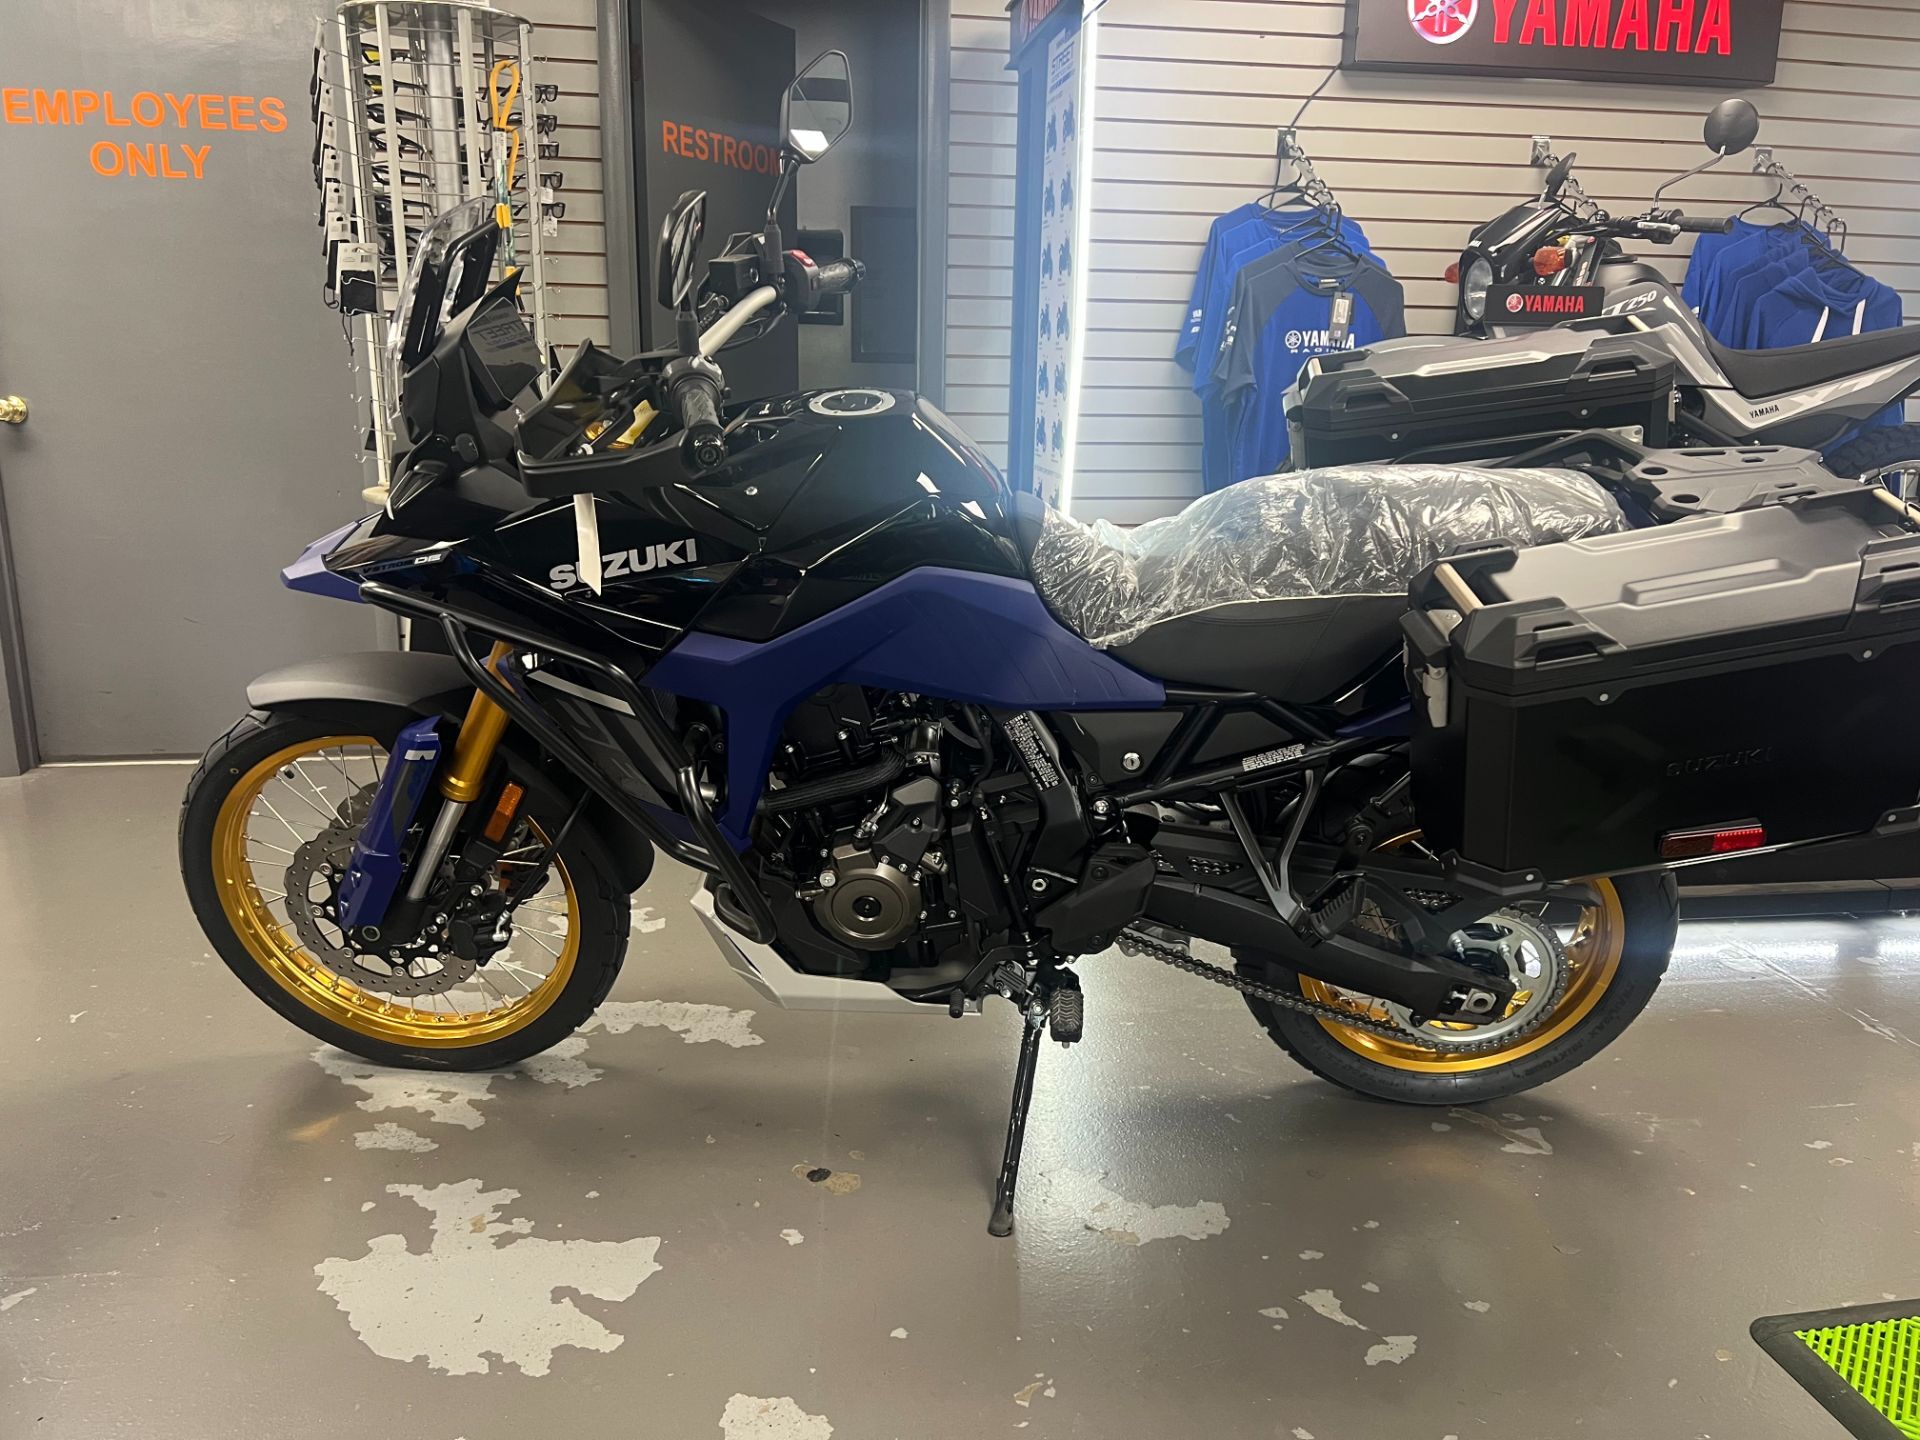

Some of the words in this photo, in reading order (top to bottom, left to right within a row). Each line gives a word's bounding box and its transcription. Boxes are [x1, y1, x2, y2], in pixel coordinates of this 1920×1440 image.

[1492, 0, 1732, 56] YAMAHA
[2, 87, 288, 133] EMPLOYEES
[90, 141, 212, 179] ONLY
[1525, 294, 1584, 313] YAMAHA
[1749, 404, 1780, 419] YAMAHA
